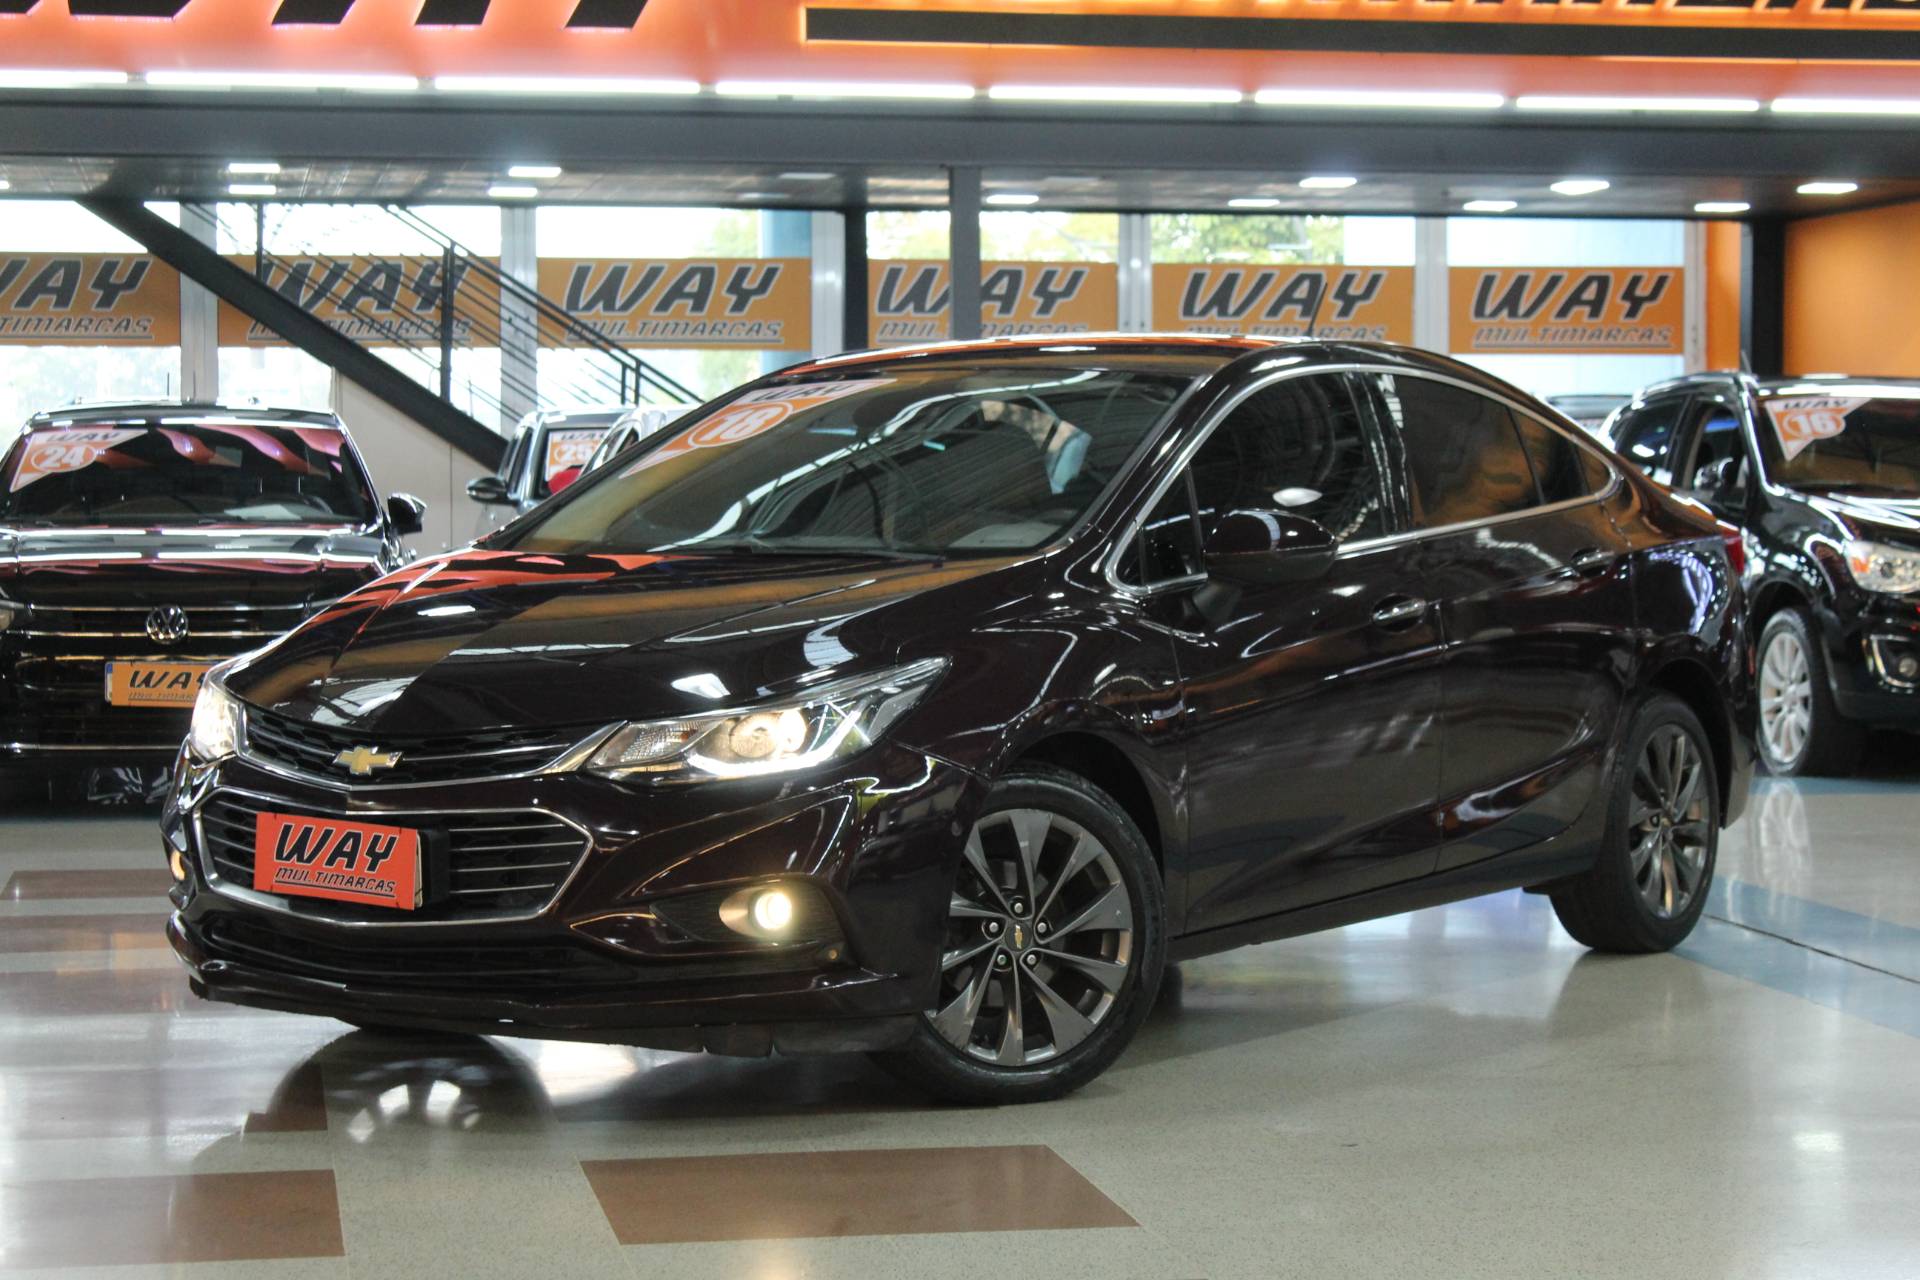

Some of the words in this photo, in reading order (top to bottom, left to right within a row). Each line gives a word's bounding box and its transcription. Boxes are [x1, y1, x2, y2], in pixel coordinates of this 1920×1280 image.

[564, 262, 783, 316] WAY
[1179, 268, 1387, 321] WAY
[1471, 271, 1674, 323] WAY
[1474, 326, 1674, 344] MULTIMARCAS
[698, 406, 785, 442] 18
[1788, 413, 1839, 435] 16
[40, 445, 86, 468] 24
[274, 821, 400, 874] WAY
[275, 867, 396, 893] MULTIMARCAS
